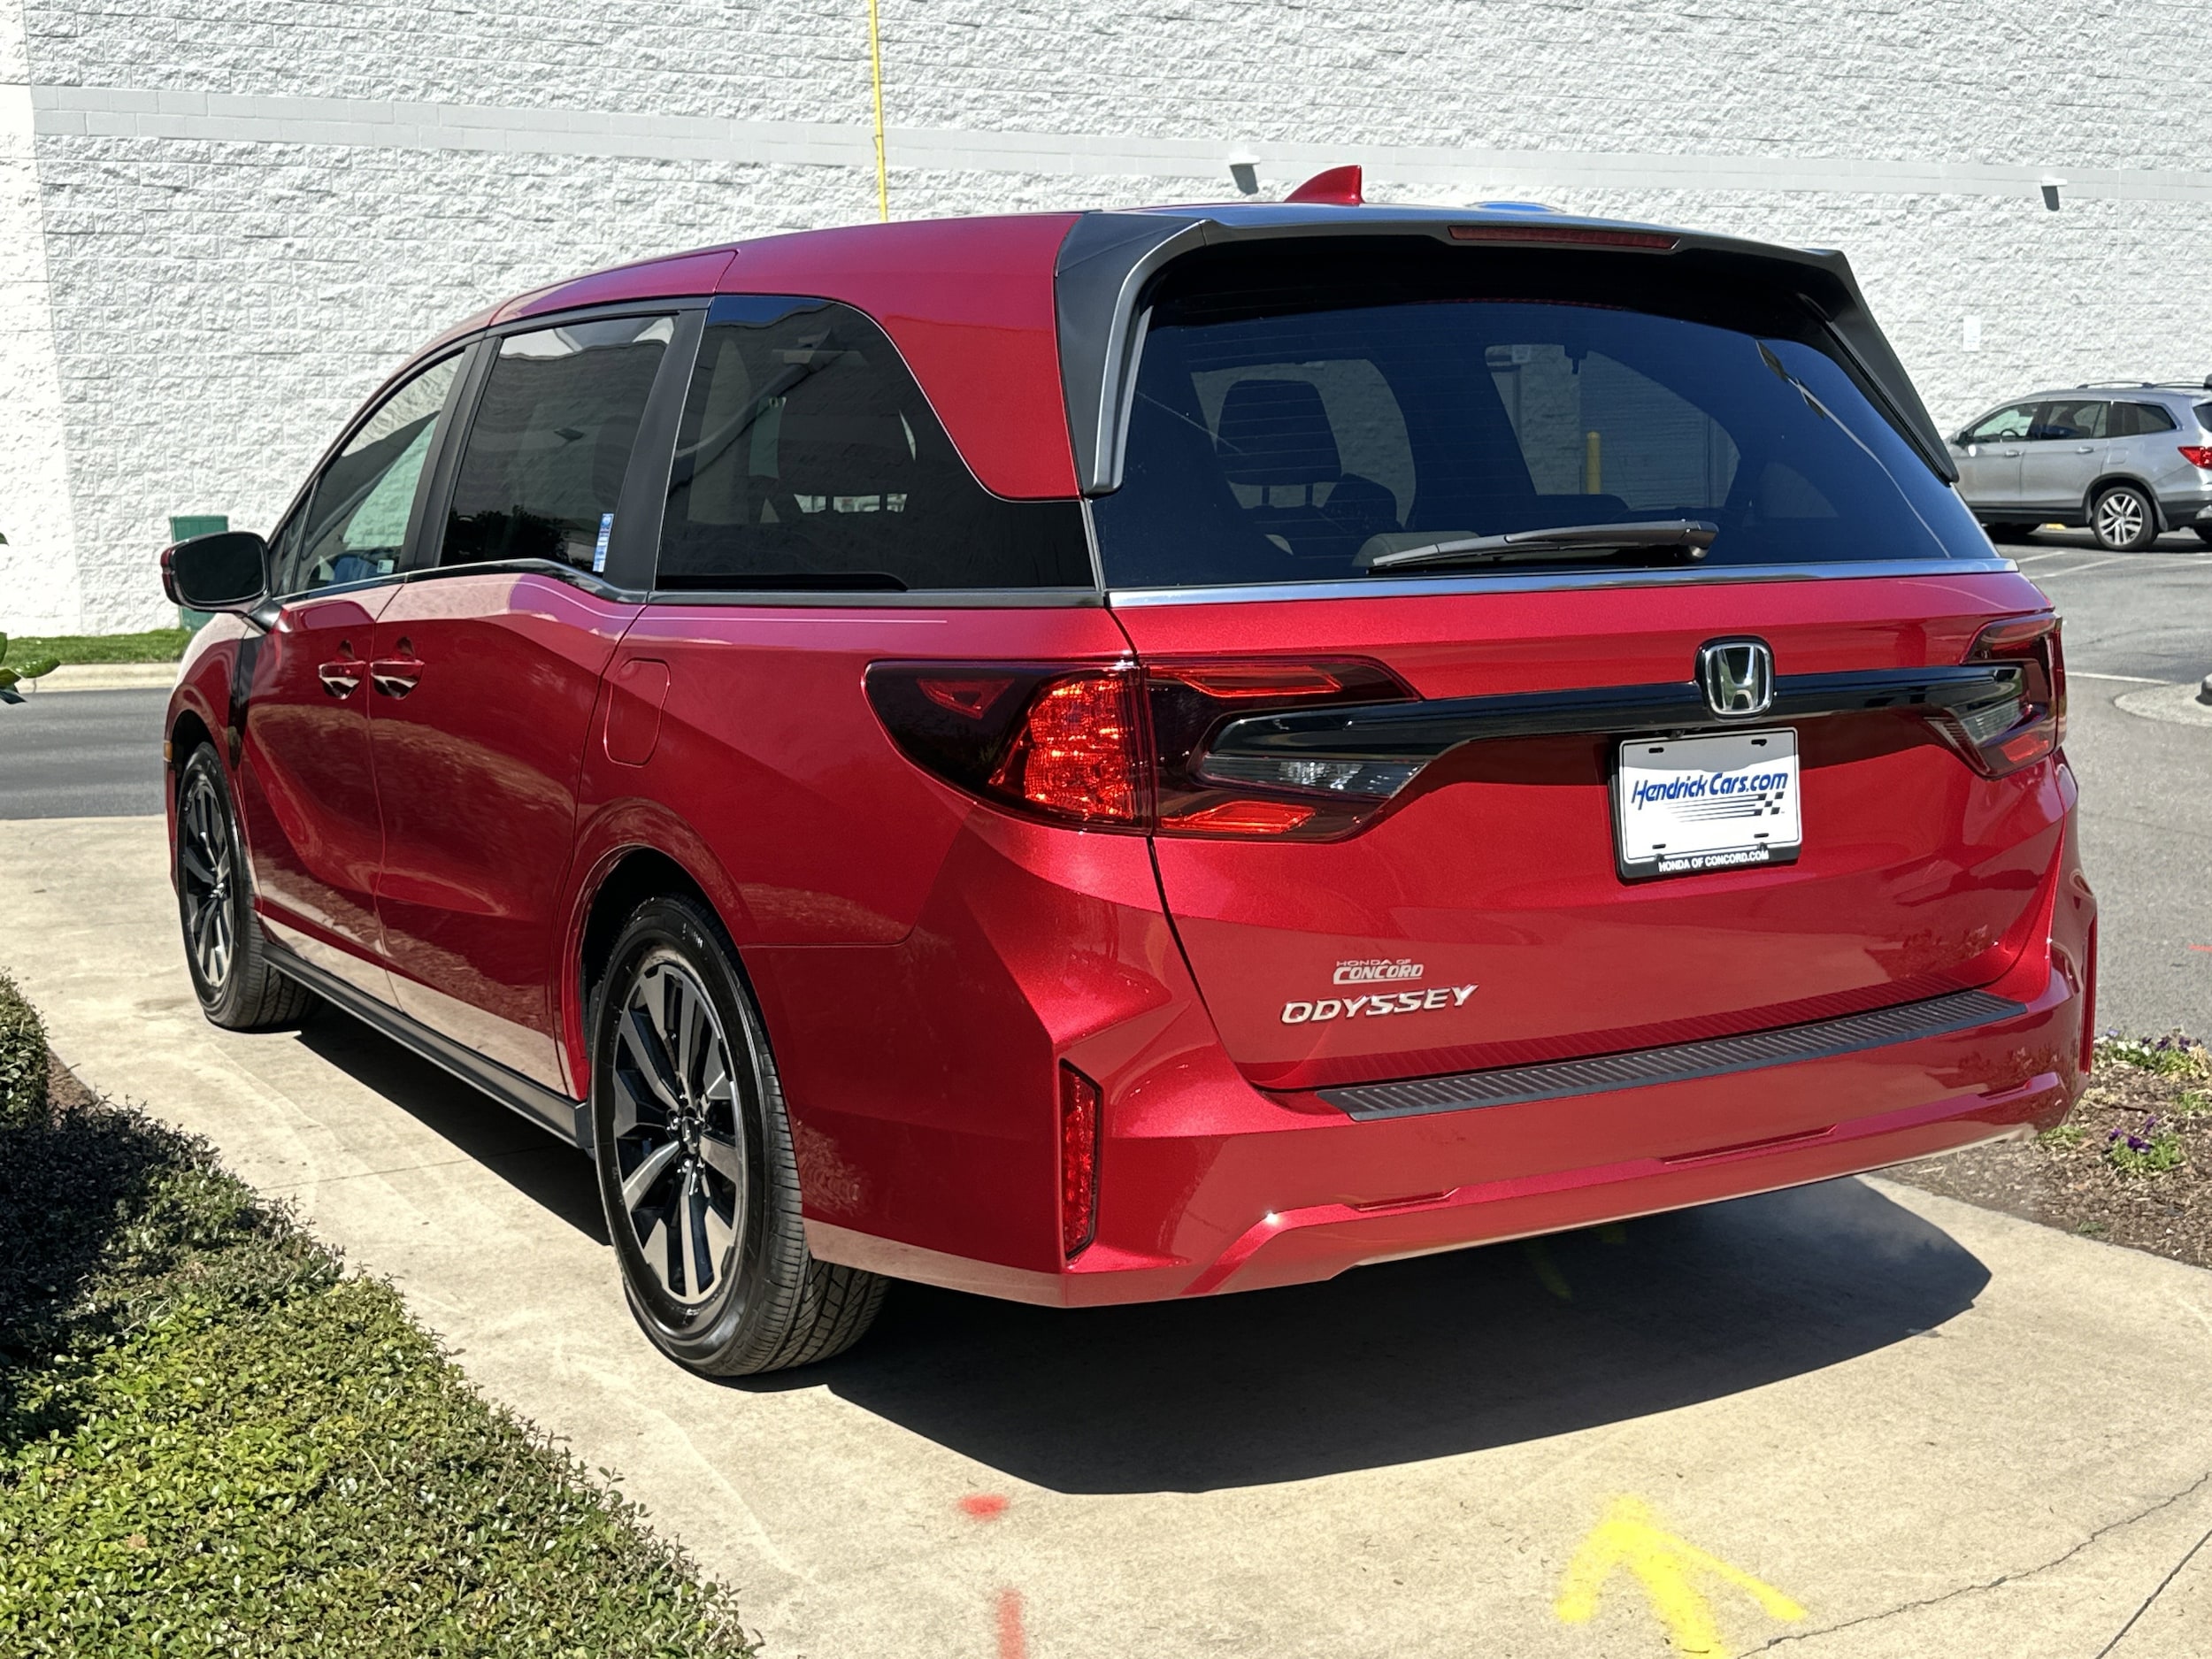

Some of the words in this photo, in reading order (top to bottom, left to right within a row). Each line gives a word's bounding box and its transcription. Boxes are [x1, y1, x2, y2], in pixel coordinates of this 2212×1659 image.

[1658, 857, 1690, 872] HONDA
[1691, 857, 1703, 868] OF
[1705, 850, 1770, 867] CONCORD.COM
[1336, 958, 1393, 967] HONDA
[1280, 984, 1479, 1025] ODYSSEY
